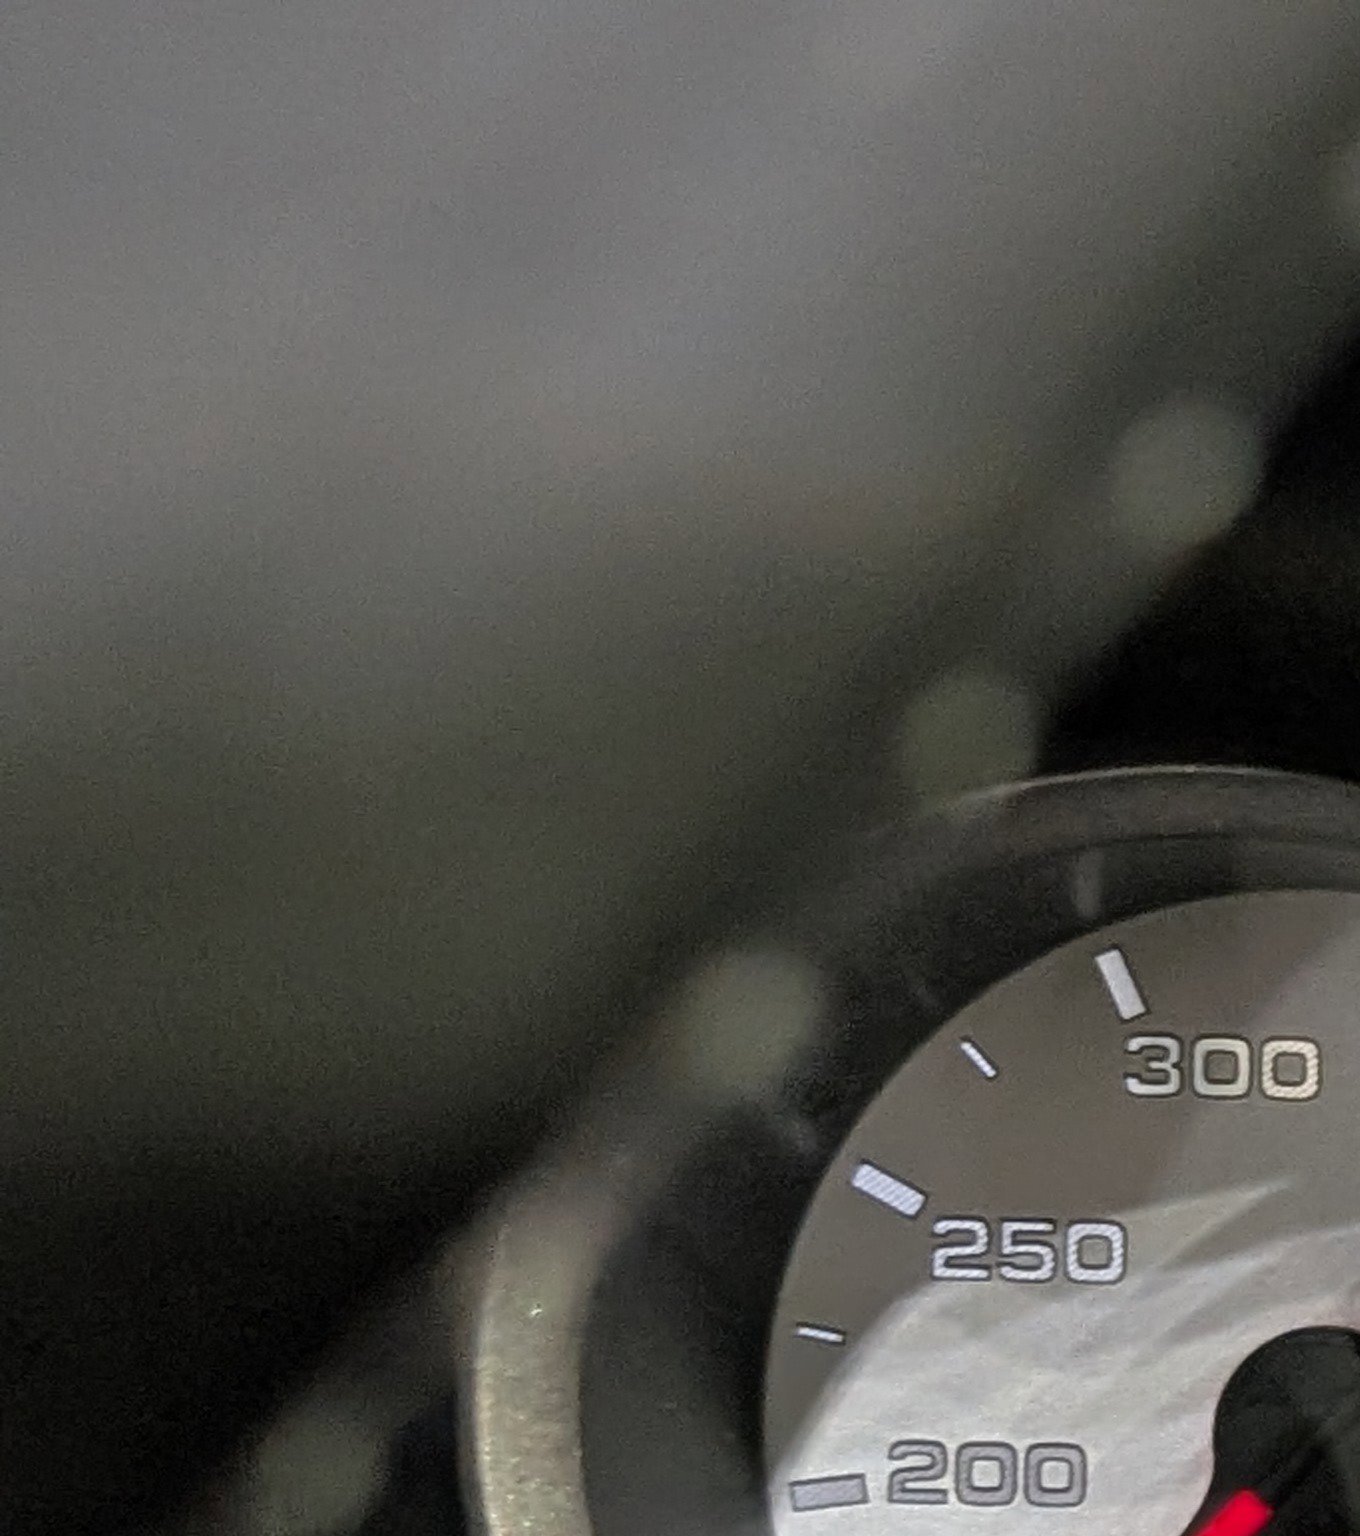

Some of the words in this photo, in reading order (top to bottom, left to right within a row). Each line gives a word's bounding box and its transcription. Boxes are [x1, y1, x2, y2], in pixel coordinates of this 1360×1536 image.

[1123, 1033, 1323, 1101] 300
[929, 1216, 1128, 1284] 250
[886, 1438, 1088, 1508] 200
